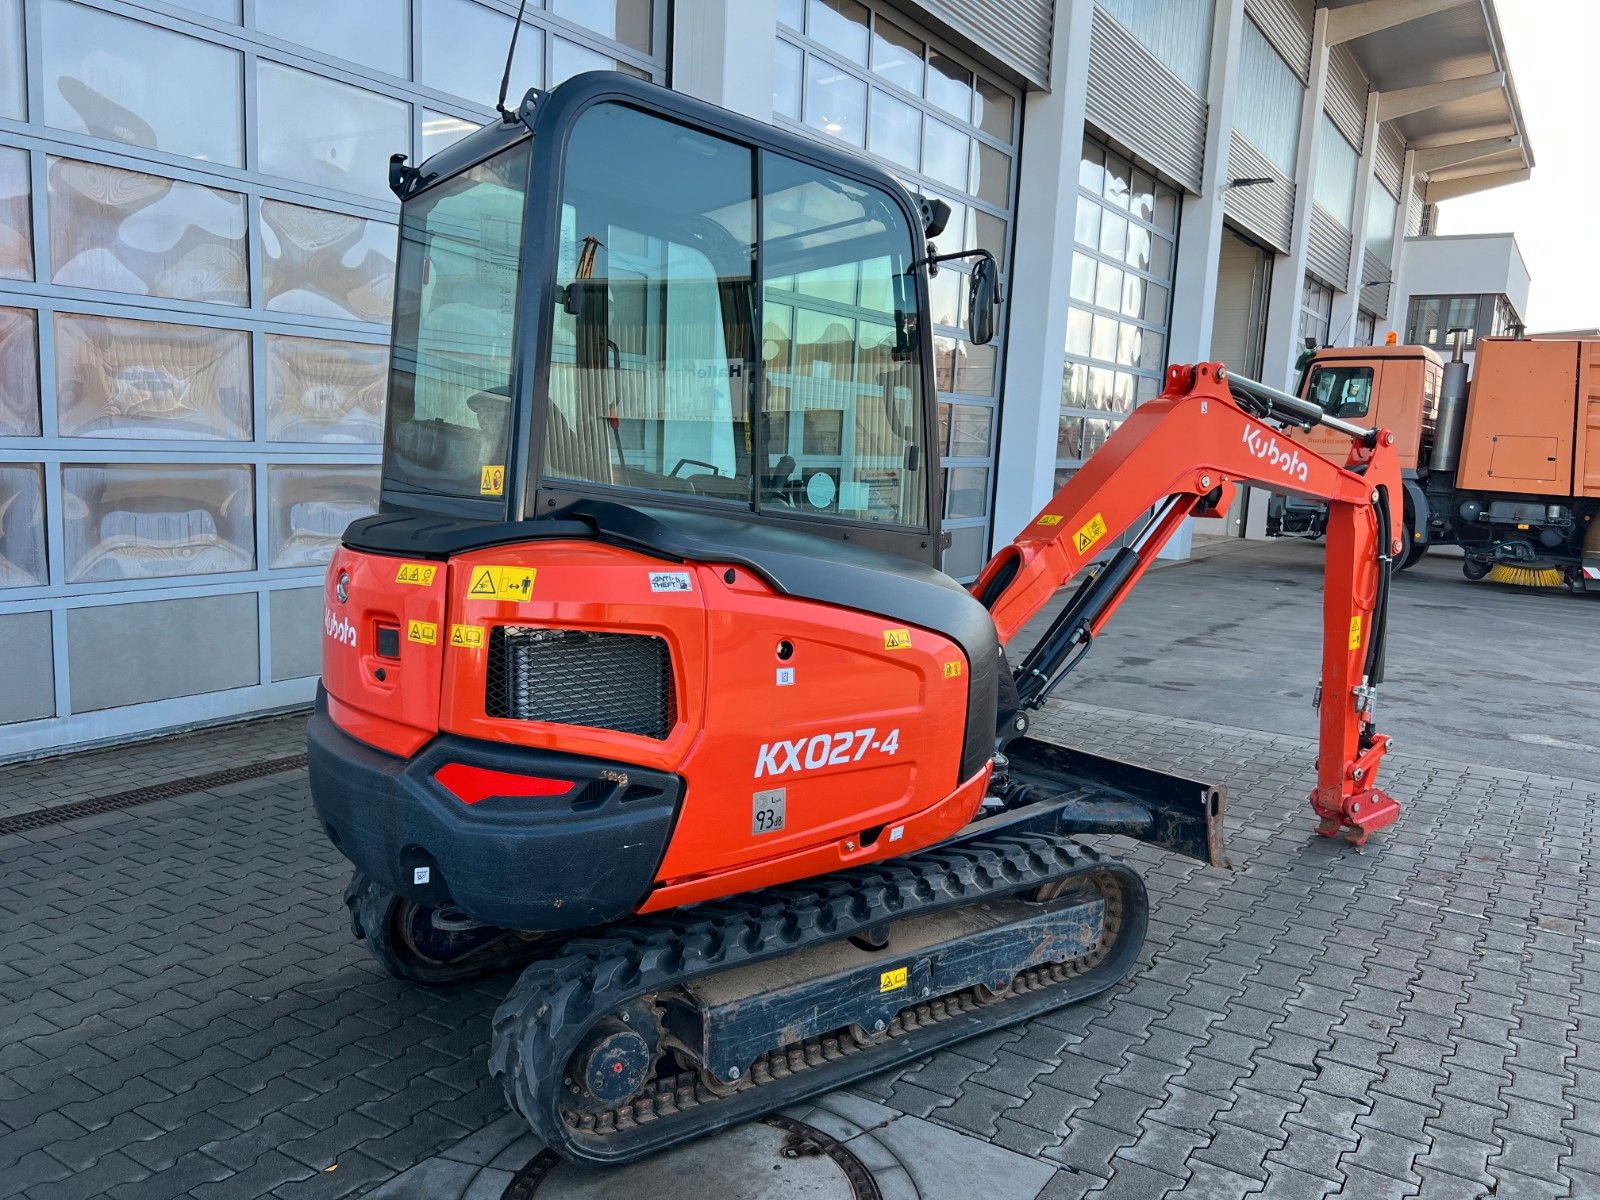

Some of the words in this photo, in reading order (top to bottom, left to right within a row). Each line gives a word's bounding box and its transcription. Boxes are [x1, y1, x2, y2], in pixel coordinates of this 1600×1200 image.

[1242, 423, 1309, 483] Kubota
[325, 607, 357, 648] Kubota
[753, 727, 900, 779] KX027-4
